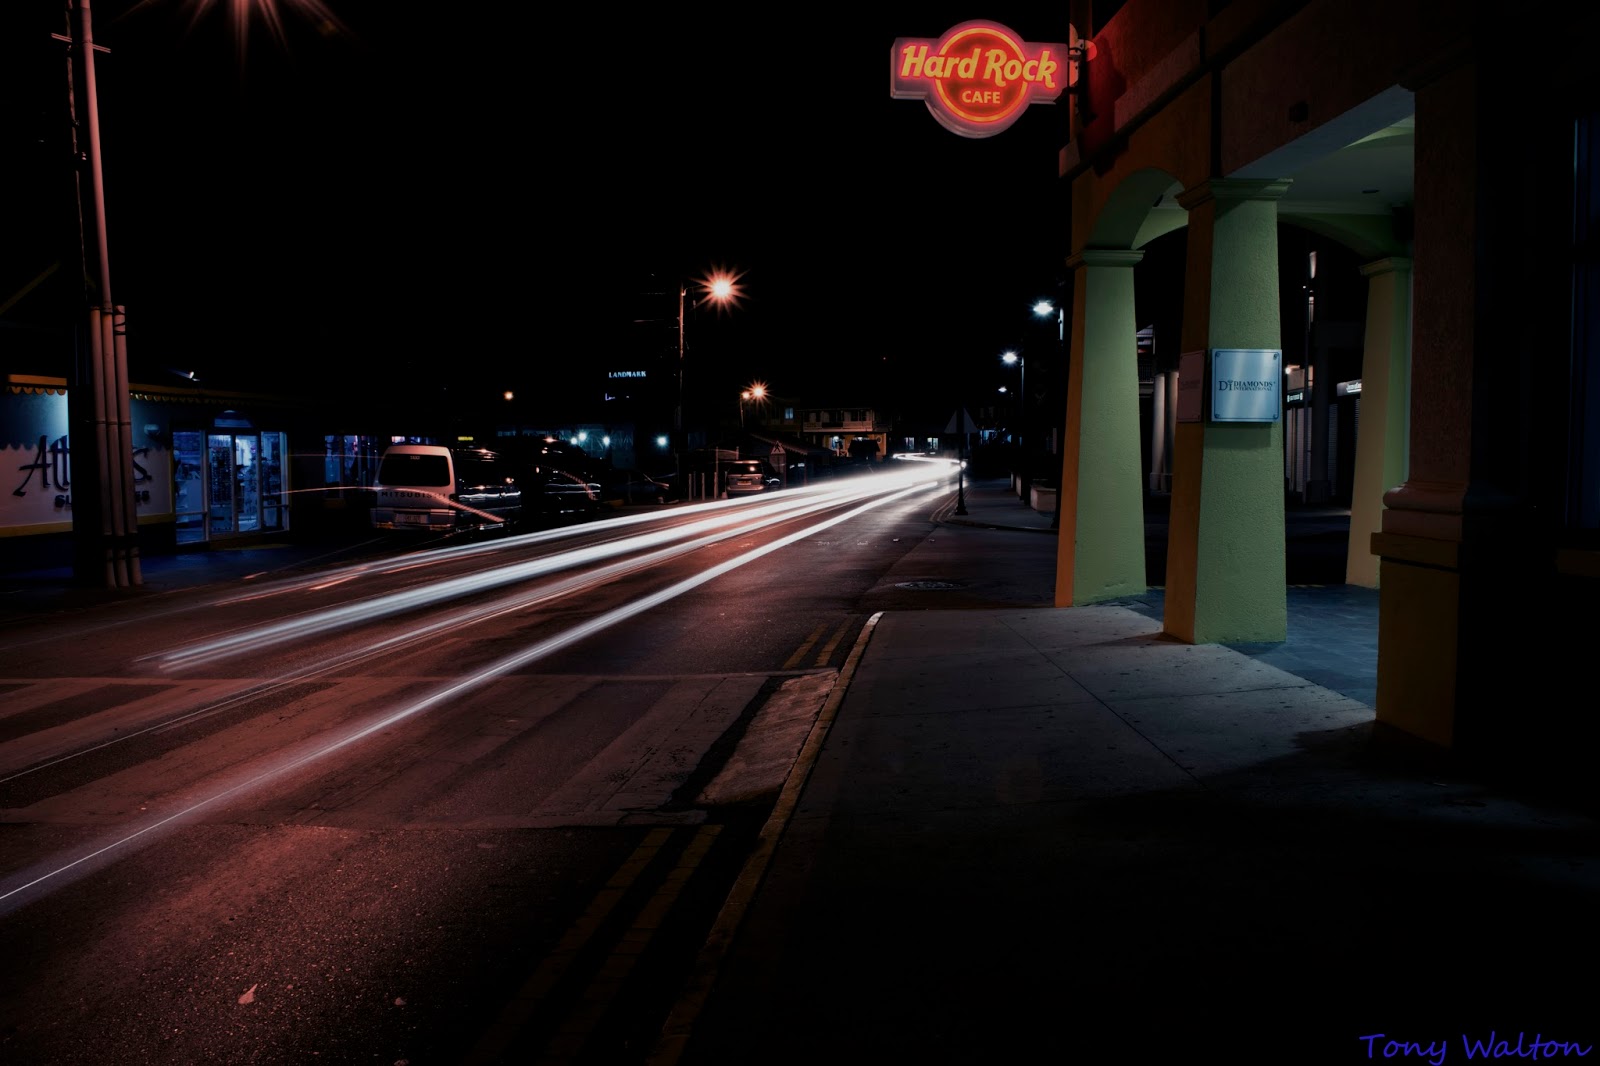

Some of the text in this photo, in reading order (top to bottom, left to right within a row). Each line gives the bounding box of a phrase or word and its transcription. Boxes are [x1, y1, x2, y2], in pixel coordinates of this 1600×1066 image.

[901, 45, 1058, 89] Hard Rock
[961, 90, 1001, 104] CAFE
